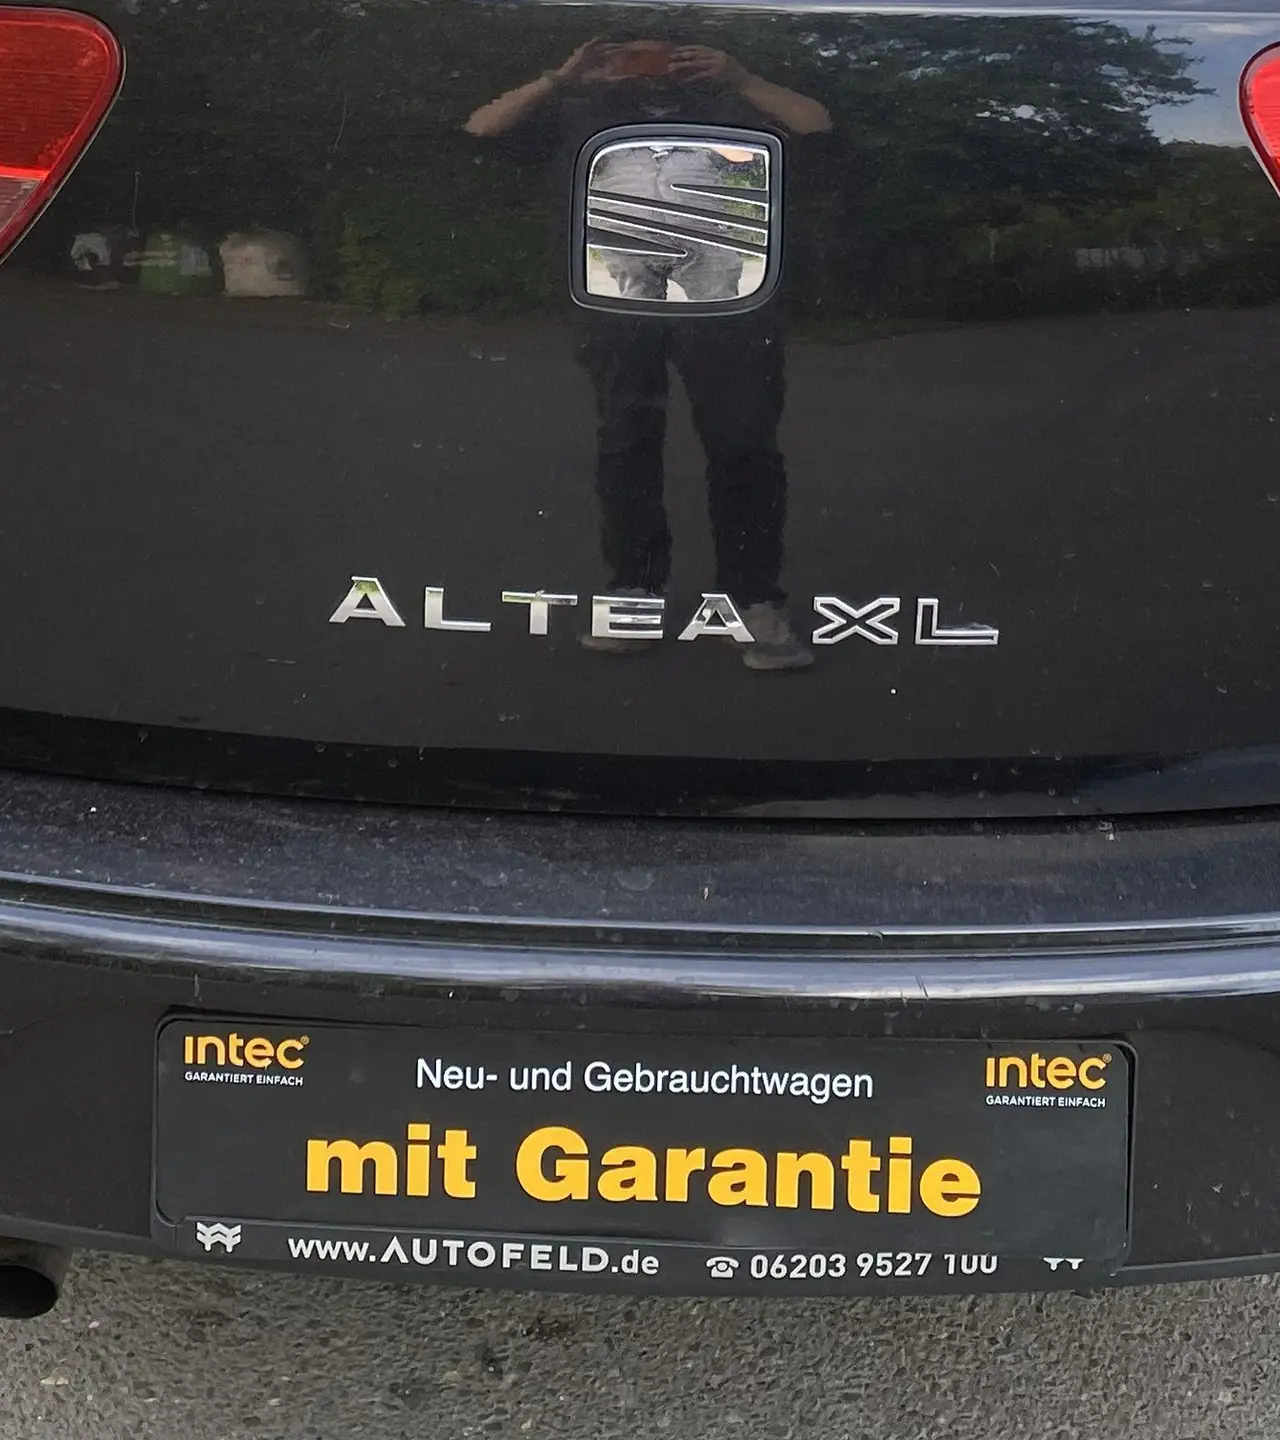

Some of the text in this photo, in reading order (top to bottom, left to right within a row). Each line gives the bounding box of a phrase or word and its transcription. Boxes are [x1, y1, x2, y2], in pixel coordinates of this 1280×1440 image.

[328, 575, 1001, 647] ALTEA XL
[184, 1071, 304, 1087] GARANTIERT EINFACH
[415, 1057, 873, 1103] Neu- und Gebrauchtwagen
[986, 1094, 1107, 1109] GARANTIERT EINFACH
[305, 1123, 982, 1217] mit Garantie
[287, 1235, 660, 1276] www.AUTOFELD.de
[750, 1253, 847, 1280] 06203
[856, 1252, 933, 1278] 9527
